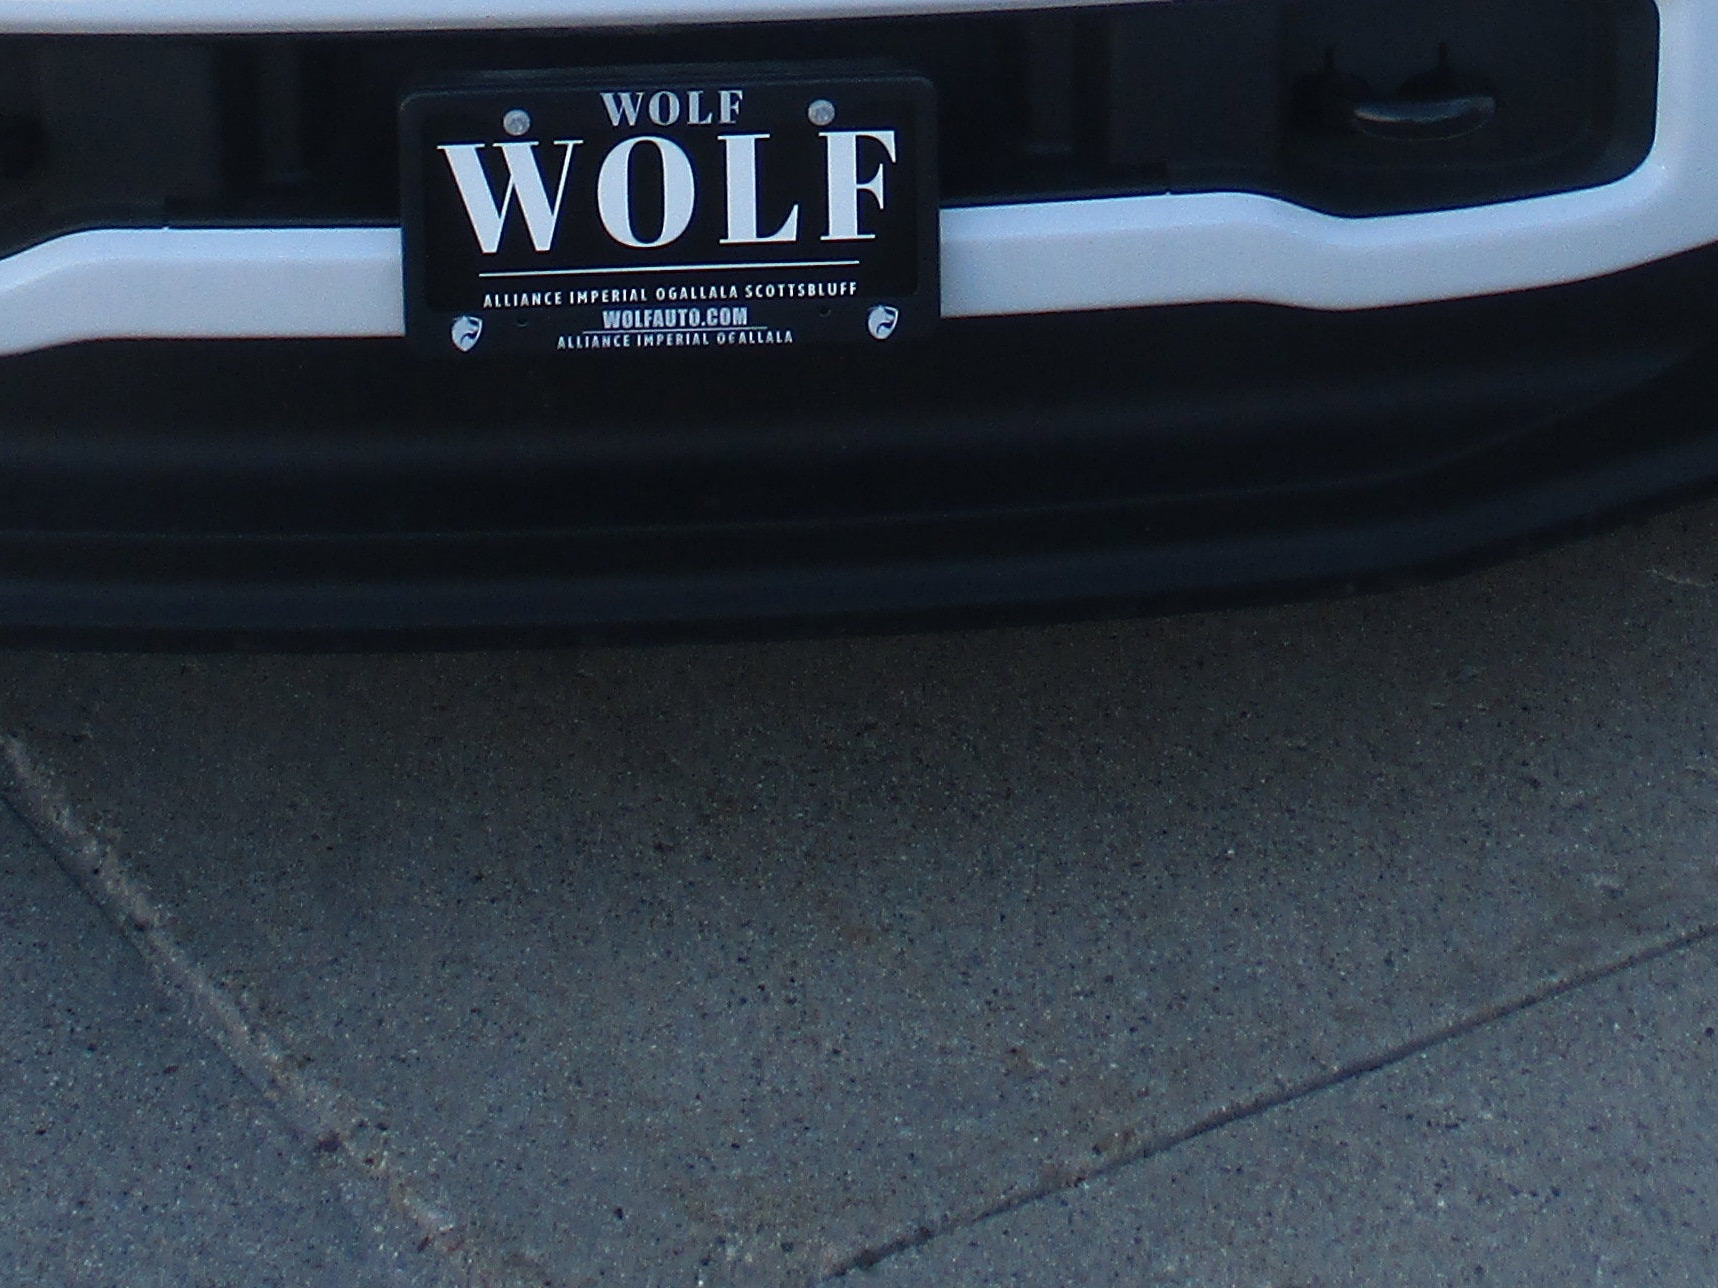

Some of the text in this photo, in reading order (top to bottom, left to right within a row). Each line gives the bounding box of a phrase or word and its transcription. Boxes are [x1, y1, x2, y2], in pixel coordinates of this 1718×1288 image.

[599, 89, 744, 126] WOLF
[436, 129, 898, 254] WOLF
[483, 281, 858, 309] ALLIANCE IMPERIAL OGALLALA SCOTTSBLUFF
[602, 307, 749, 329] WOLFAUTO.COM
[556, 335, 631, 350] ALLIANCE
[636, 332, 710, 347] IMPERIAL
